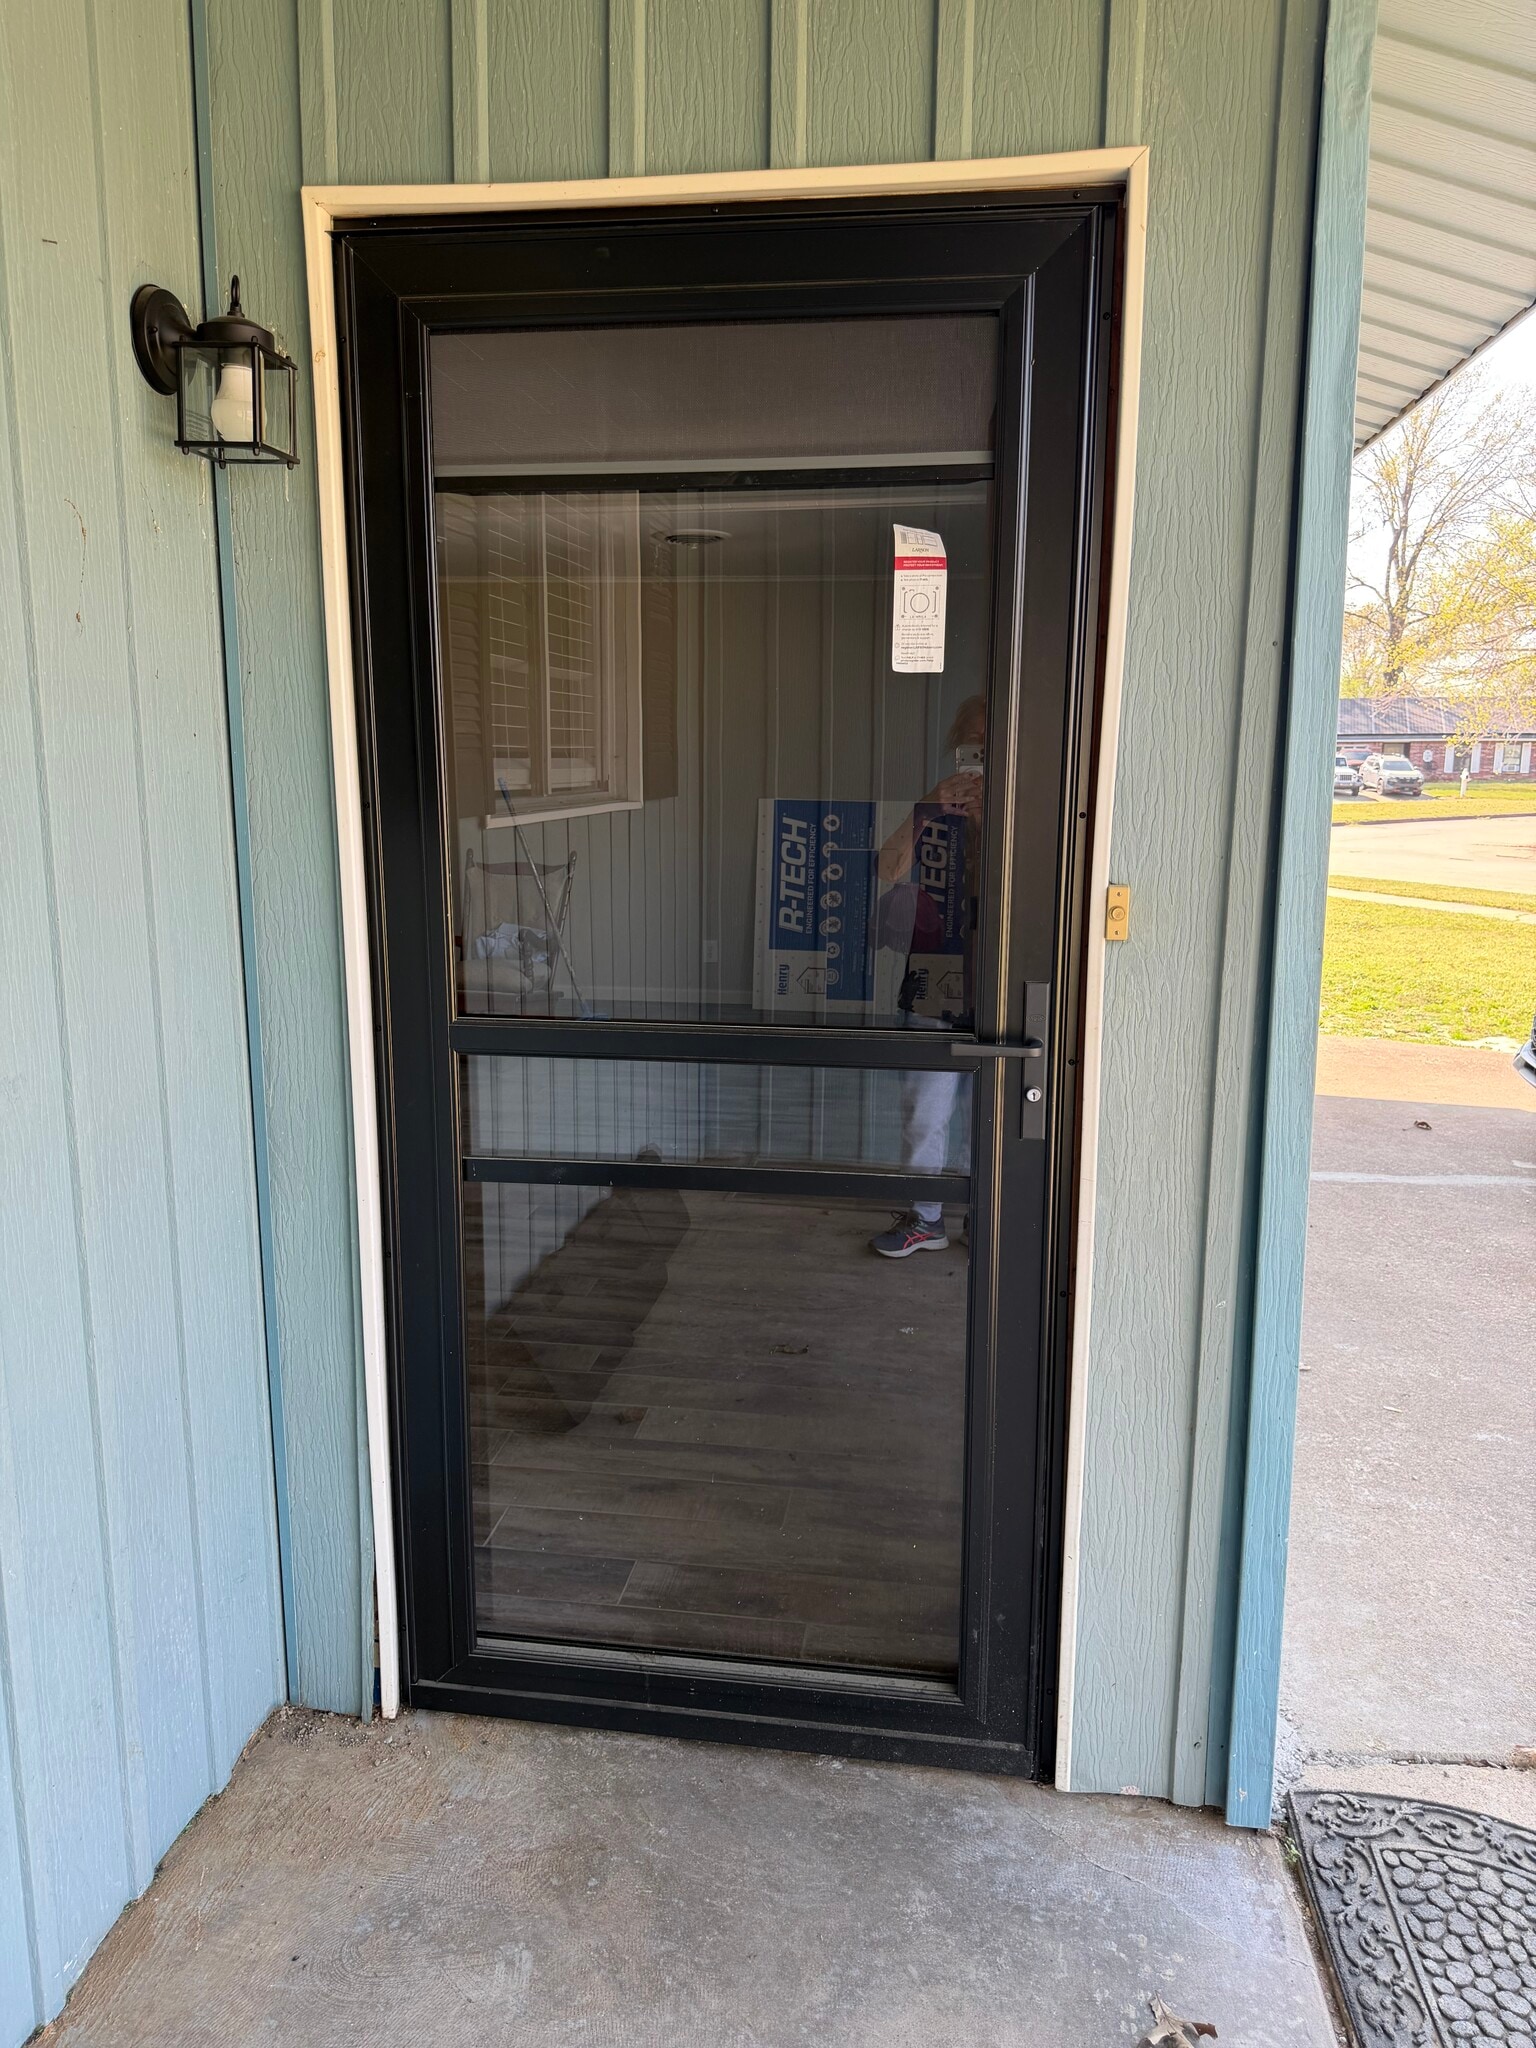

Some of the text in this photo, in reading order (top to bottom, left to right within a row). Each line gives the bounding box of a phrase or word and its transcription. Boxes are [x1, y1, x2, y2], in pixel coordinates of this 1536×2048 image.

[778, 816, 807, 934] R-TECH
[806, 823, 818, 935] ENGINEERED FOR EFFICIENCY
[946, 826, 959, 938] ENGINEERED FOR EFFICIENCY
[777, 963, 791, 996] Henry
[915, 968, 930, 1001] Henry
